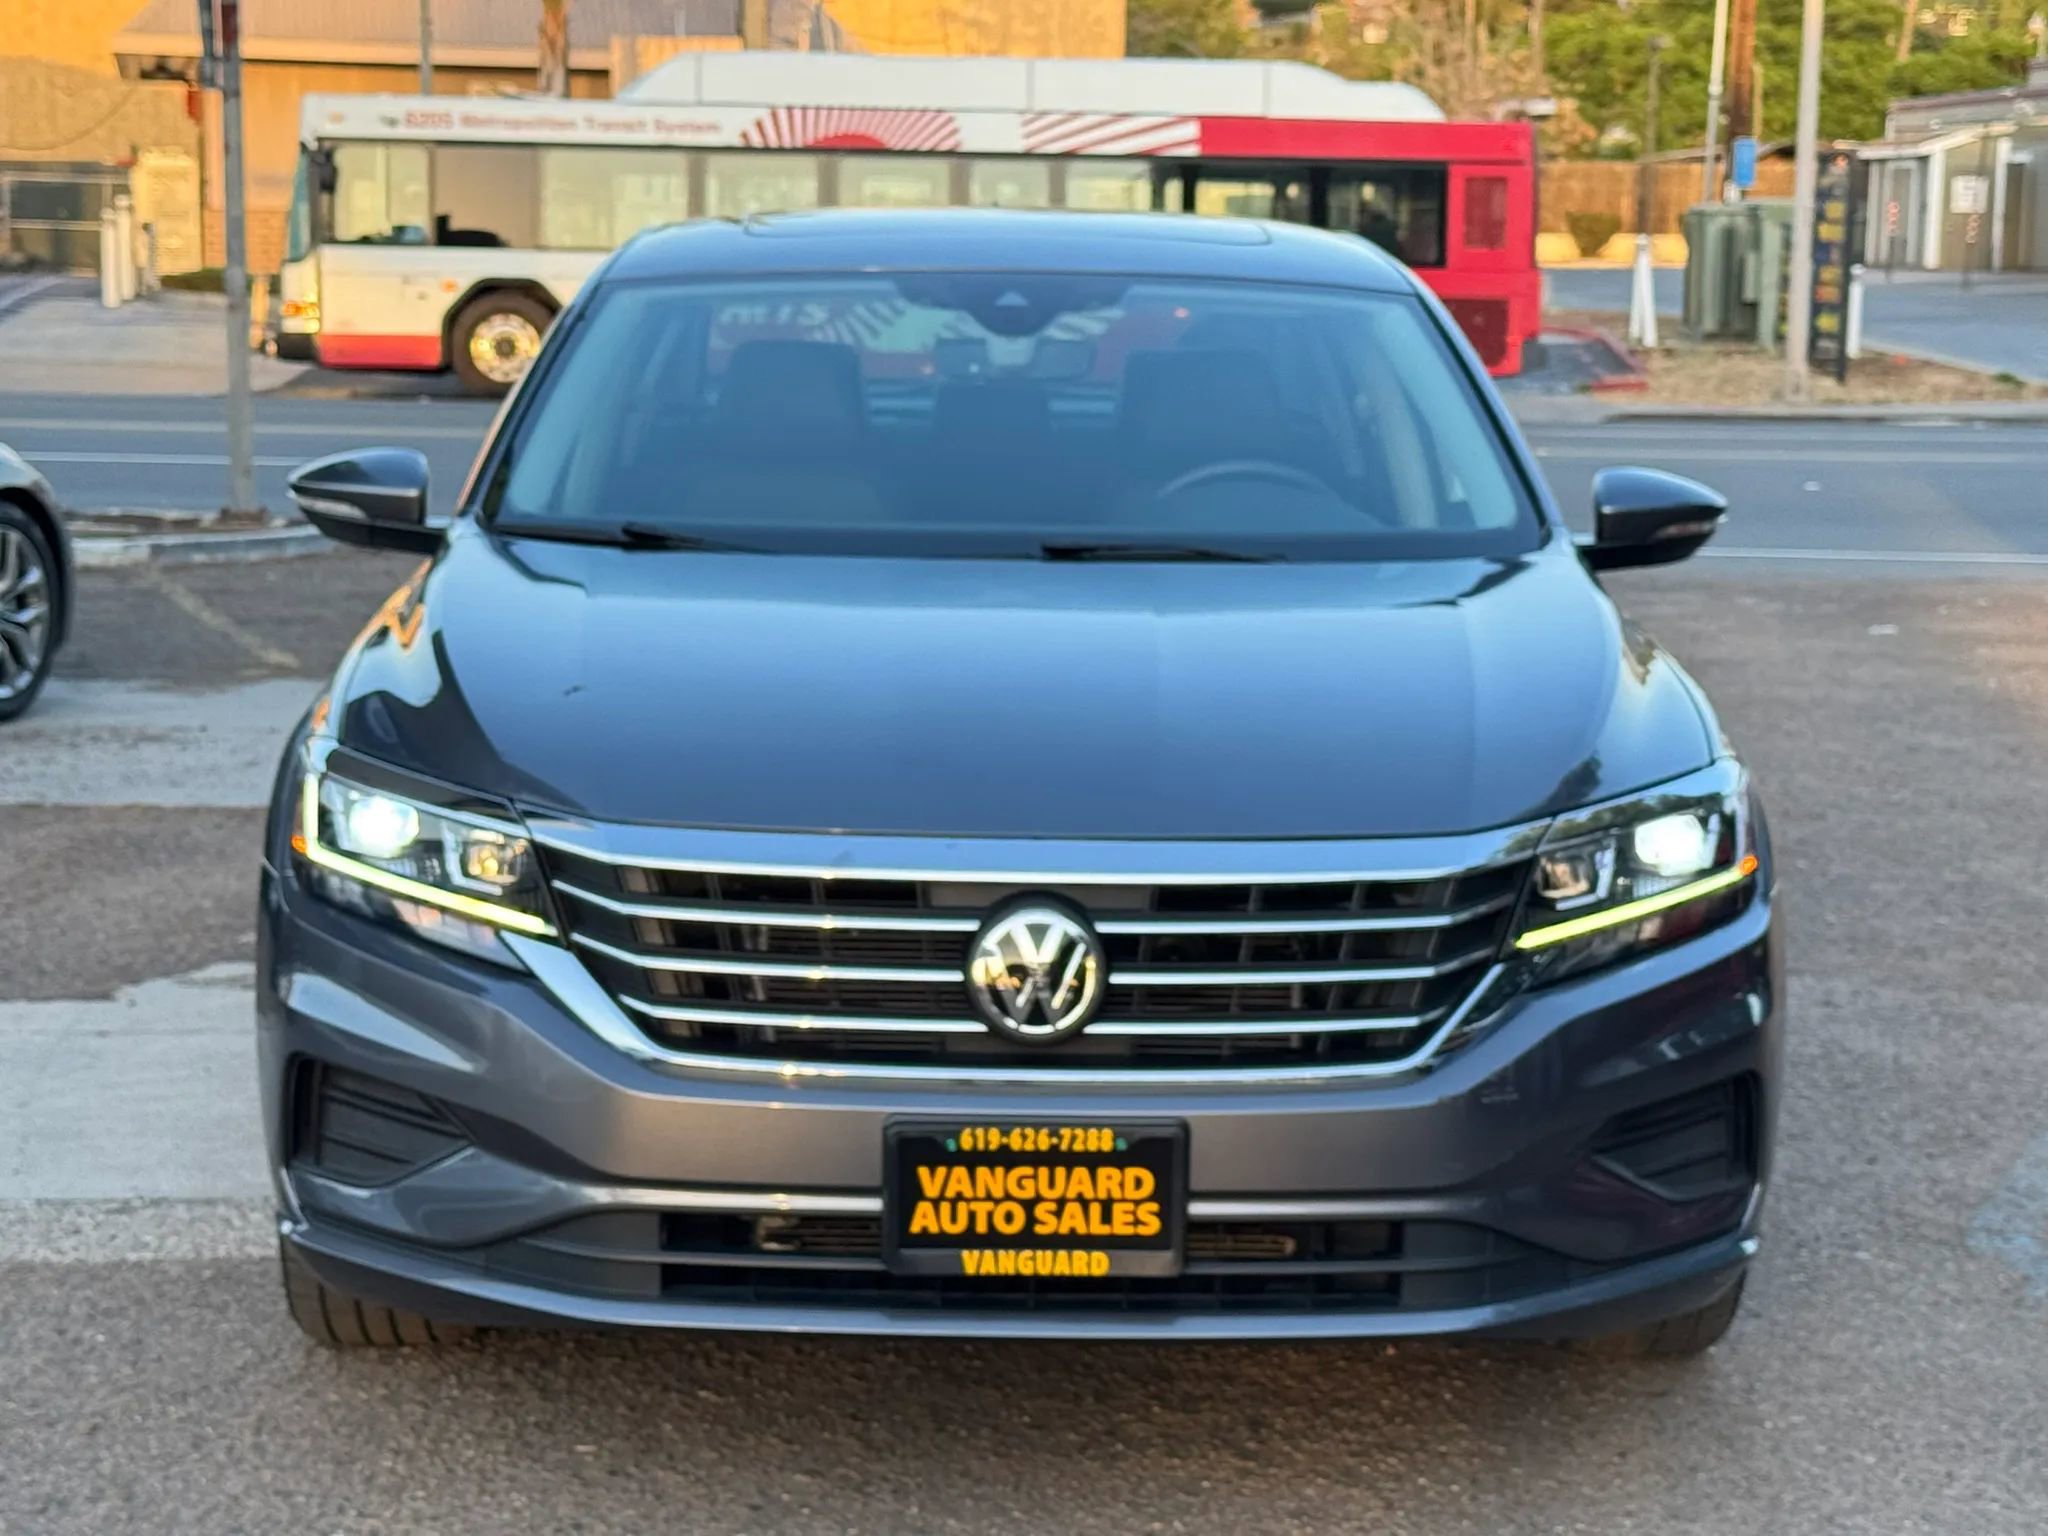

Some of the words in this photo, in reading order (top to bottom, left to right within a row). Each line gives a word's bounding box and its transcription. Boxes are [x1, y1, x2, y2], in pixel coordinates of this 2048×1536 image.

[959, 1127, 1114, 1152] 619-626-7288
[916, 1165, 1156, 1200] VANGUARD
[908, 1201, 1027, 1235] AUTO
[1032, 1202, 1162, 1236] SALES
[961, 1249, 1111, 1277] VANGUARD
